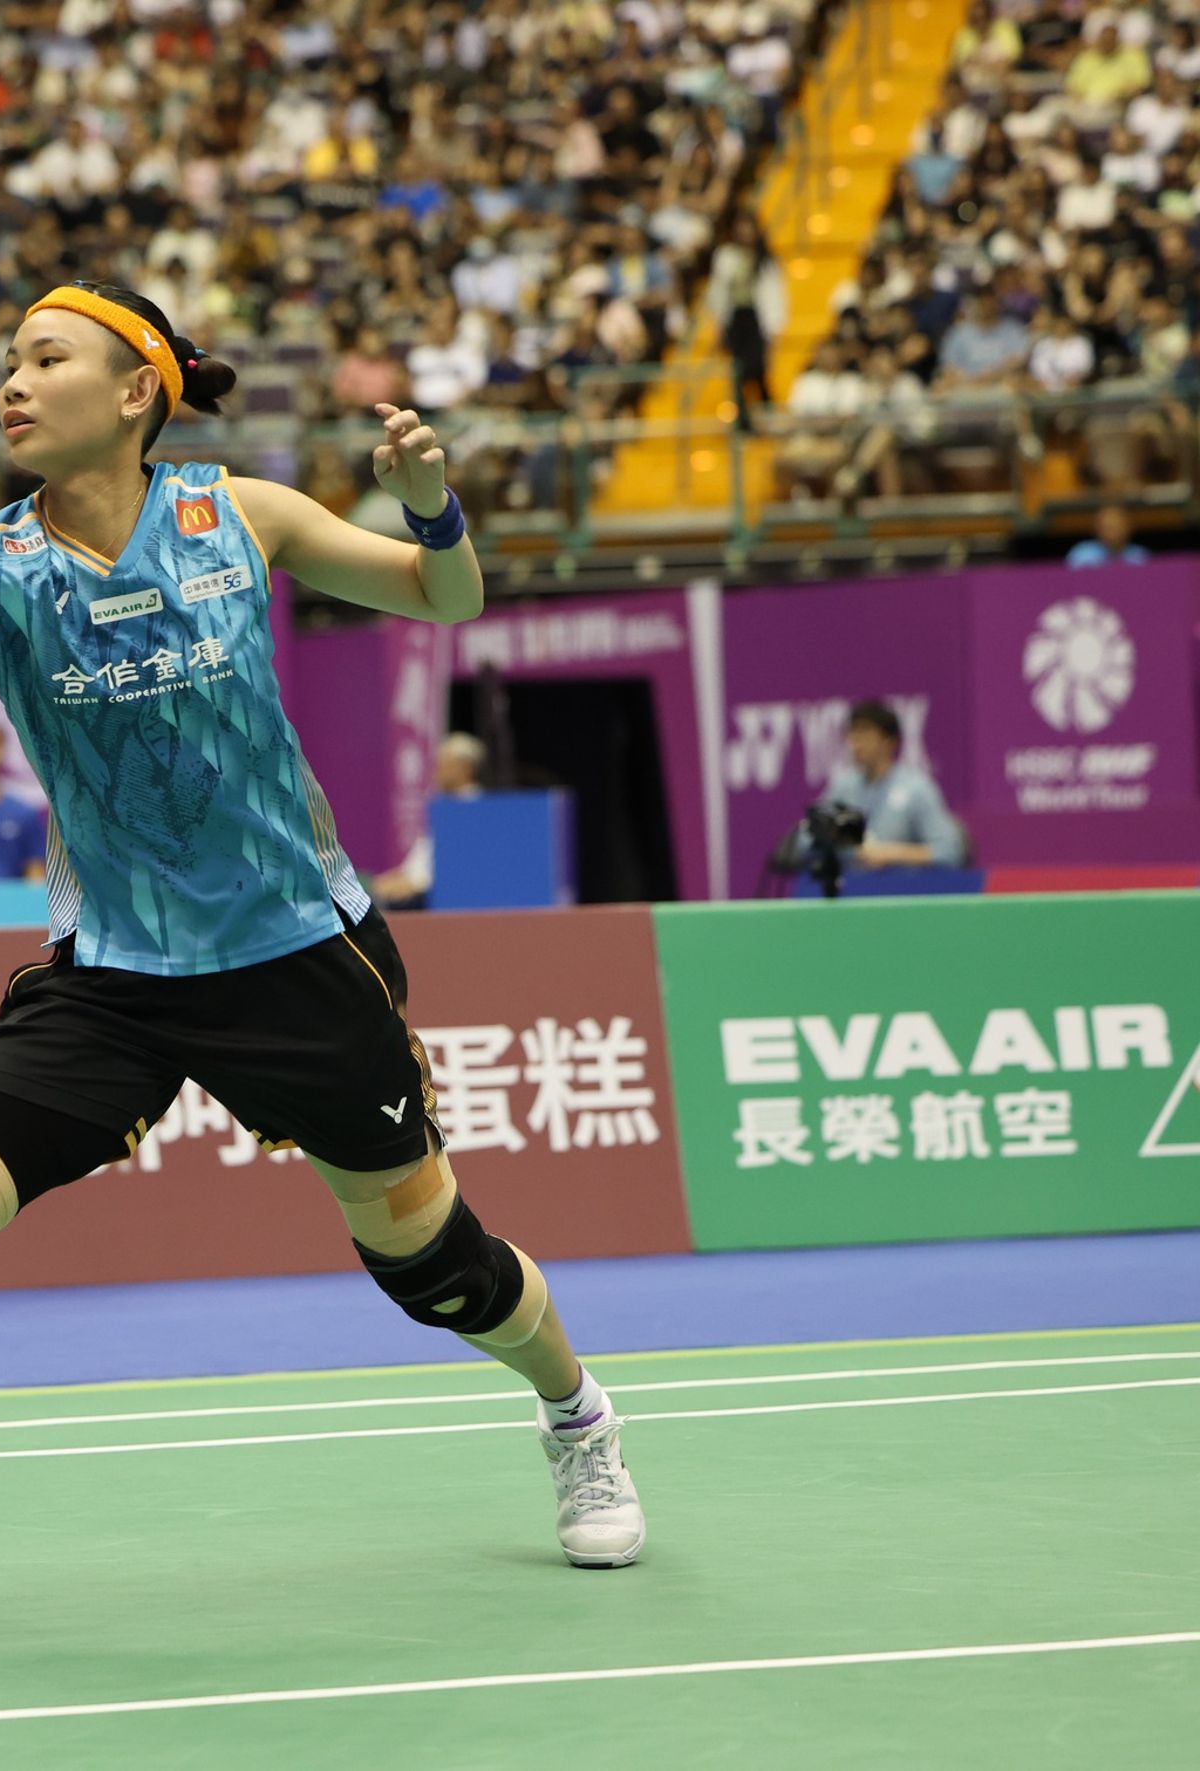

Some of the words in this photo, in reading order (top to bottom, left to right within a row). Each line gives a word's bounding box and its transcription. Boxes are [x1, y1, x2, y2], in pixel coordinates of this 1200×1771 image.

[223, 571, 242, 590] 5G
[94, 607, 120, 619] EVA
[121, 602, 144, 614] AIR
[51, 636, 230, 695] 合作金庫
[53, 697, 99, 705] TAIWAN
[108, 680, 192, 704] COOPERATIVE
[202, 669, 234, 684] BANK
[719, 1012, 962, 1085] EVA
[968, 1003, 1174, 1075] AIR
[732, 1088, 1079, 1169] 長榮航空
